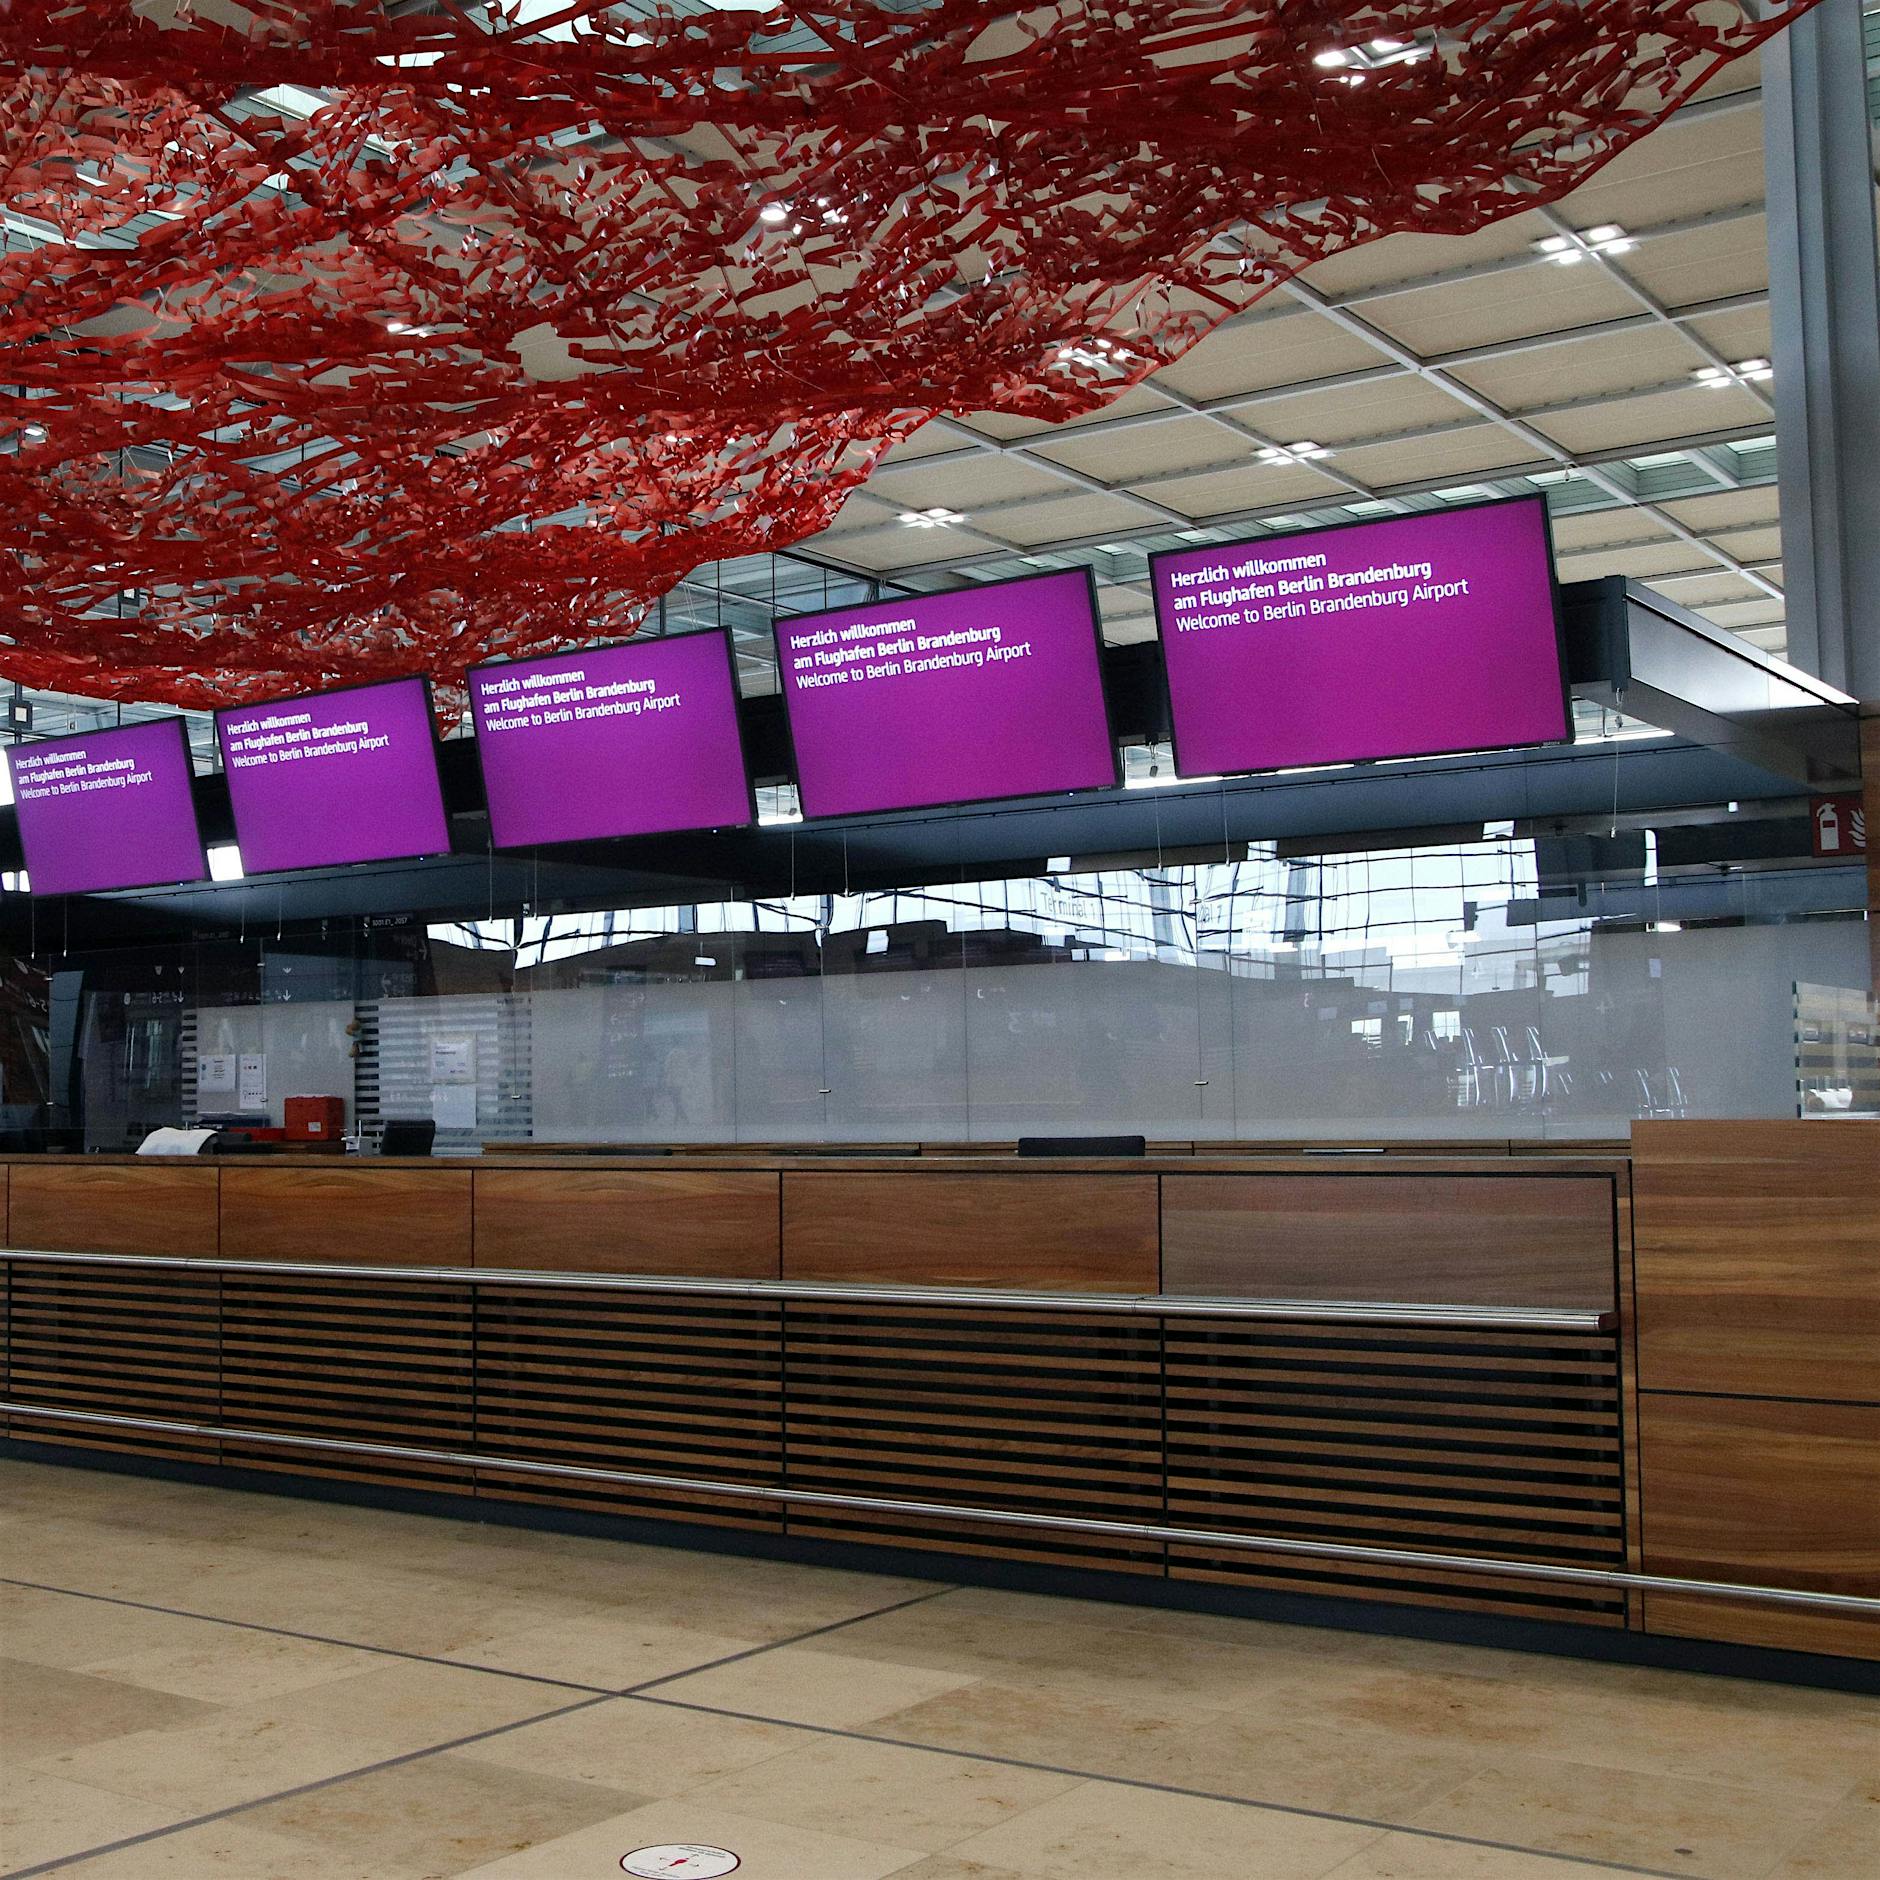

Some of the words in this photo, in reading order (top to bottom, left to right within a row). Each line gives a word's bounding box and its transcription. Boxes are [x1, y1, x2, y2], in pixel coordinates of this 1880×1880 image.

[1170, 565, 1230, 588] Herzlich
[1231, 552, 1327, 579] willkommen
[1173, 594, 1198, 611] am
[1200, 583, 1275, 609] Flughafen
[1278, 575, 1324, 597] Berlin
[1327, 561, 1432, 589] Brandenburg
[1175, 611, 1241, 633] Welcome
[1243, 607, 1260, 624] to
[1262, 601, 1306, 622] Berlin
[1309, 589, 1409, 616] Brandenburg
[1411, 578, 1469, 603] Airport
[790, 629, 838, 650] Herzlich
[840, 618, 916, 642] willkommen
[793, 655, 813, 670] am
[814, 645, 875, 668] Flughafen
[877, 638, 915, 657] Berlin
[917, 625, 1001, 651] Brandenburg
[796, 670, 849, 689] Welcome
[850, 667, 864, 682] to
[866, 662, 901, 680] Berlin
[903, 651, 983, 674] Brandenburg
[985, 641, 1032, 664] Airport
[480, 677, 521, 696] Herzlich
[522, 670, 585, 690] willkommen
[483, 701, 500, 714] am
[501, 692, 552, 713] Flughafen
[553, 687, 584, 705] Berlin
[585, 677, 656, 700] Brandenburg
[227, 720, 260, 736] Herzlich
[260, 713, 311, 730] willkommen
[486, 714, 530, 732] Welcome
[531, 712, 542, 726] to
[543, 707, 573, 725] Berlin
[575, 698, 641, 720] Brandenburg
[643, 693, 681, 713] Airport
[230, 740, 243, 752] am
[244, 733, 285, 751] Flughafen
[286, 729, 311, 744] Berlin
[312, 721, 368, 740] Brandenburg
[232, 753, 268, 768] Welcome
[268, 751, 278, 763] to
[279, 747, 303, 762] Berlin
[304, 739, 358, 758] Brandenburg
[358, 734, 389, 751] Airport
[15, 755, 43, 769] Herzlich
[43, 750, 87, 765] willkommen
[18, 775, 30, 785] am
[30, 768, 65, 784] Flughafen
[65, 765, 87, 778] Berlin
[87, 758, 135, 771] Brandenburg
[20, 785, 51, 800] Welcome
[50, 785, 59, 796] to
[60, 781, 80, 794] Berlin
[81, 775, 126, 790] Brandenburg
[126, 770, 153, 786] Airport
